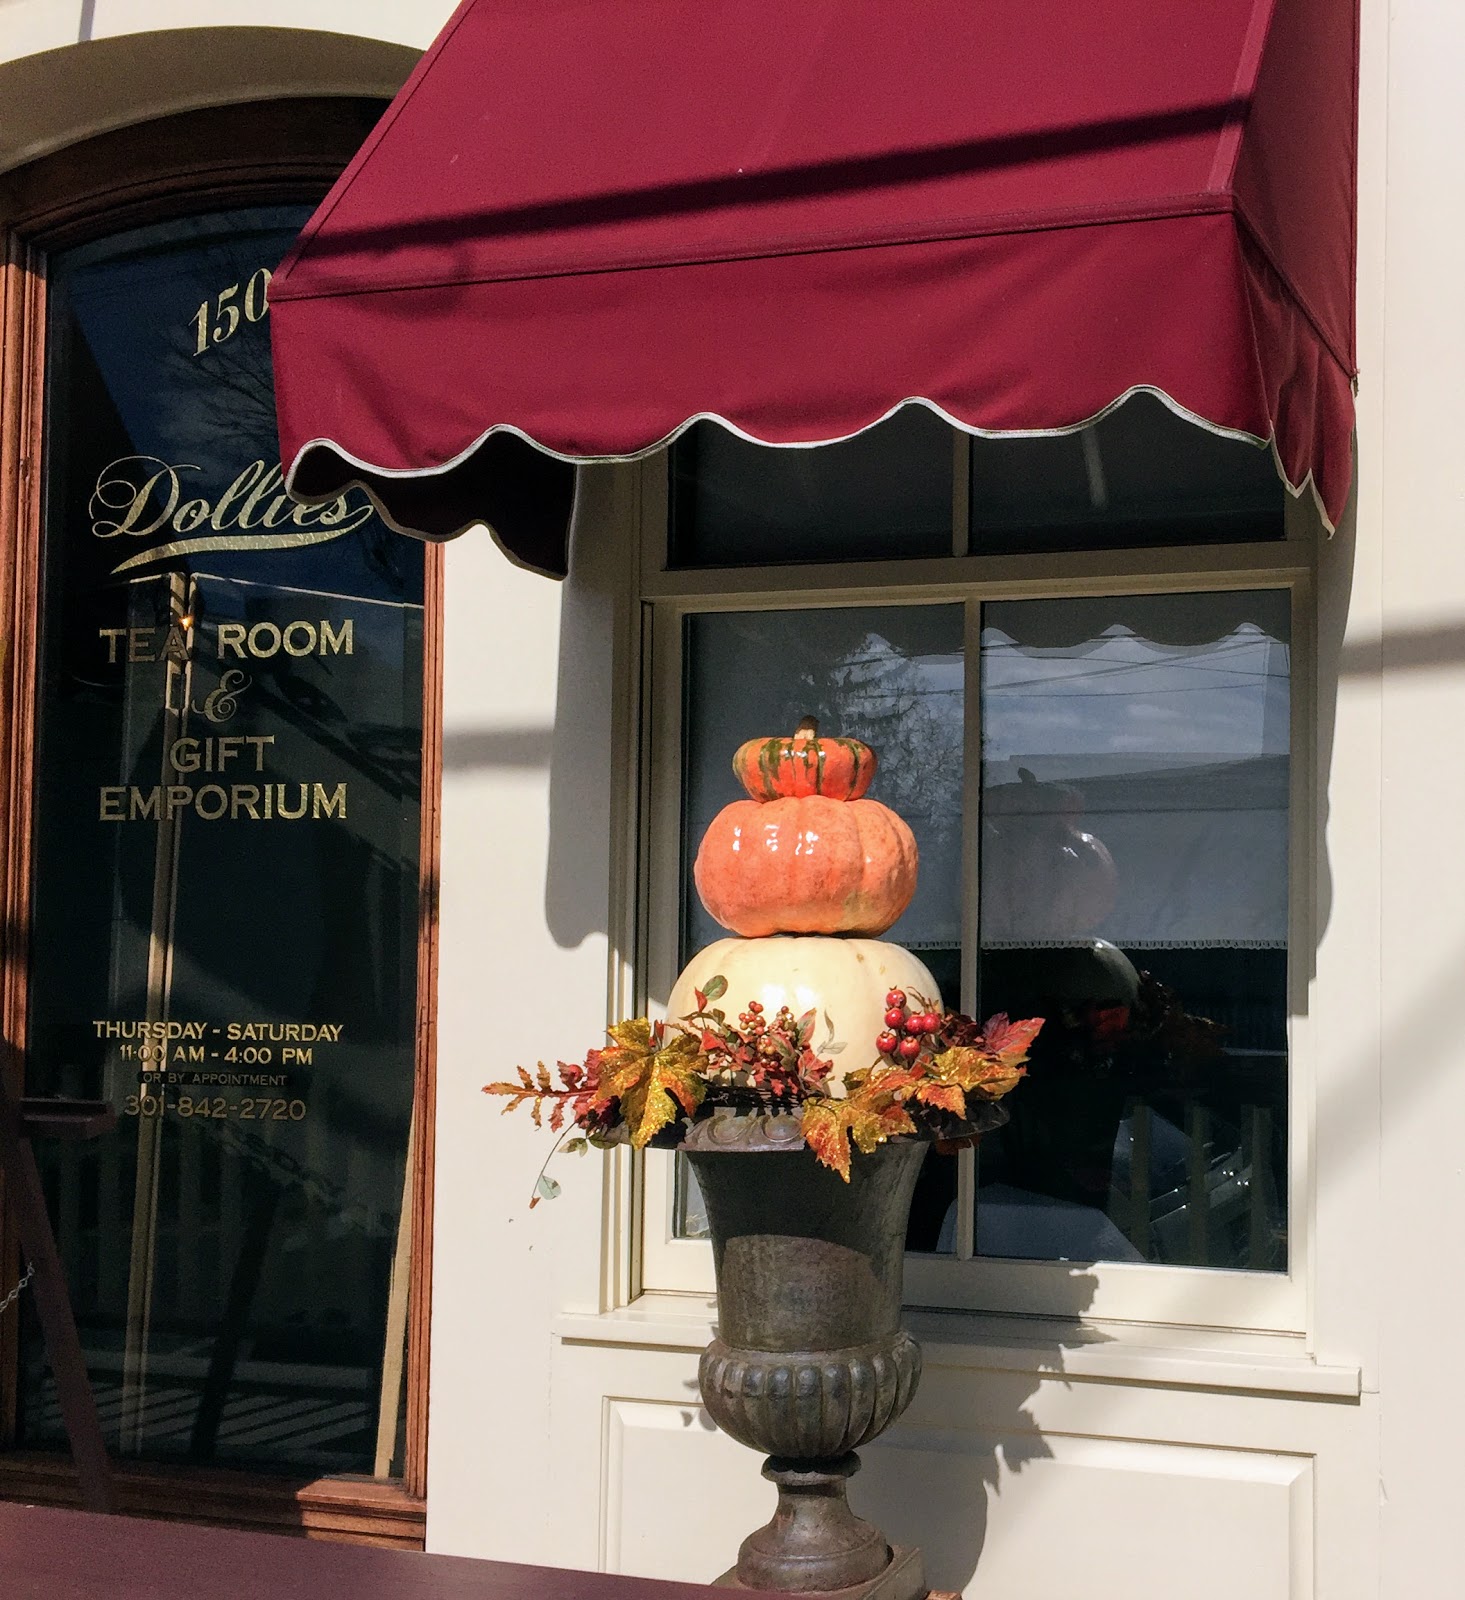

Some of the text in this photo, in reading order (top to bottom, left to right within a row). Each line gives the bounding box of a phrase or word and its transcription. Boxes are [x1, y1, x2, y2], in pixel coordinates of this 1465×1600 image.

[189, 267, 272, 356] 150
[99, 619, 354, 664] TEA ROOM
[191, 669, 253, 723] &
[169, 735, 275, 774] GIFT
[99, 782, 348, 822] EMPORIUM
[93, 1020, 208, 1041] THURSDAY
[227, 1023, 344, 1043] SATURDAY
[120, 1044, 166, 1063] 11:00
[173, 1045, 205, 1064] AM
[224, 1046, 272, 1065] 4:00
[282, 1047, 314, 1066] PM
[143, 1072, 288, 1087] OR BY APPOINTMENT
[124, 1094, 308, 1122] 301-842-2720
